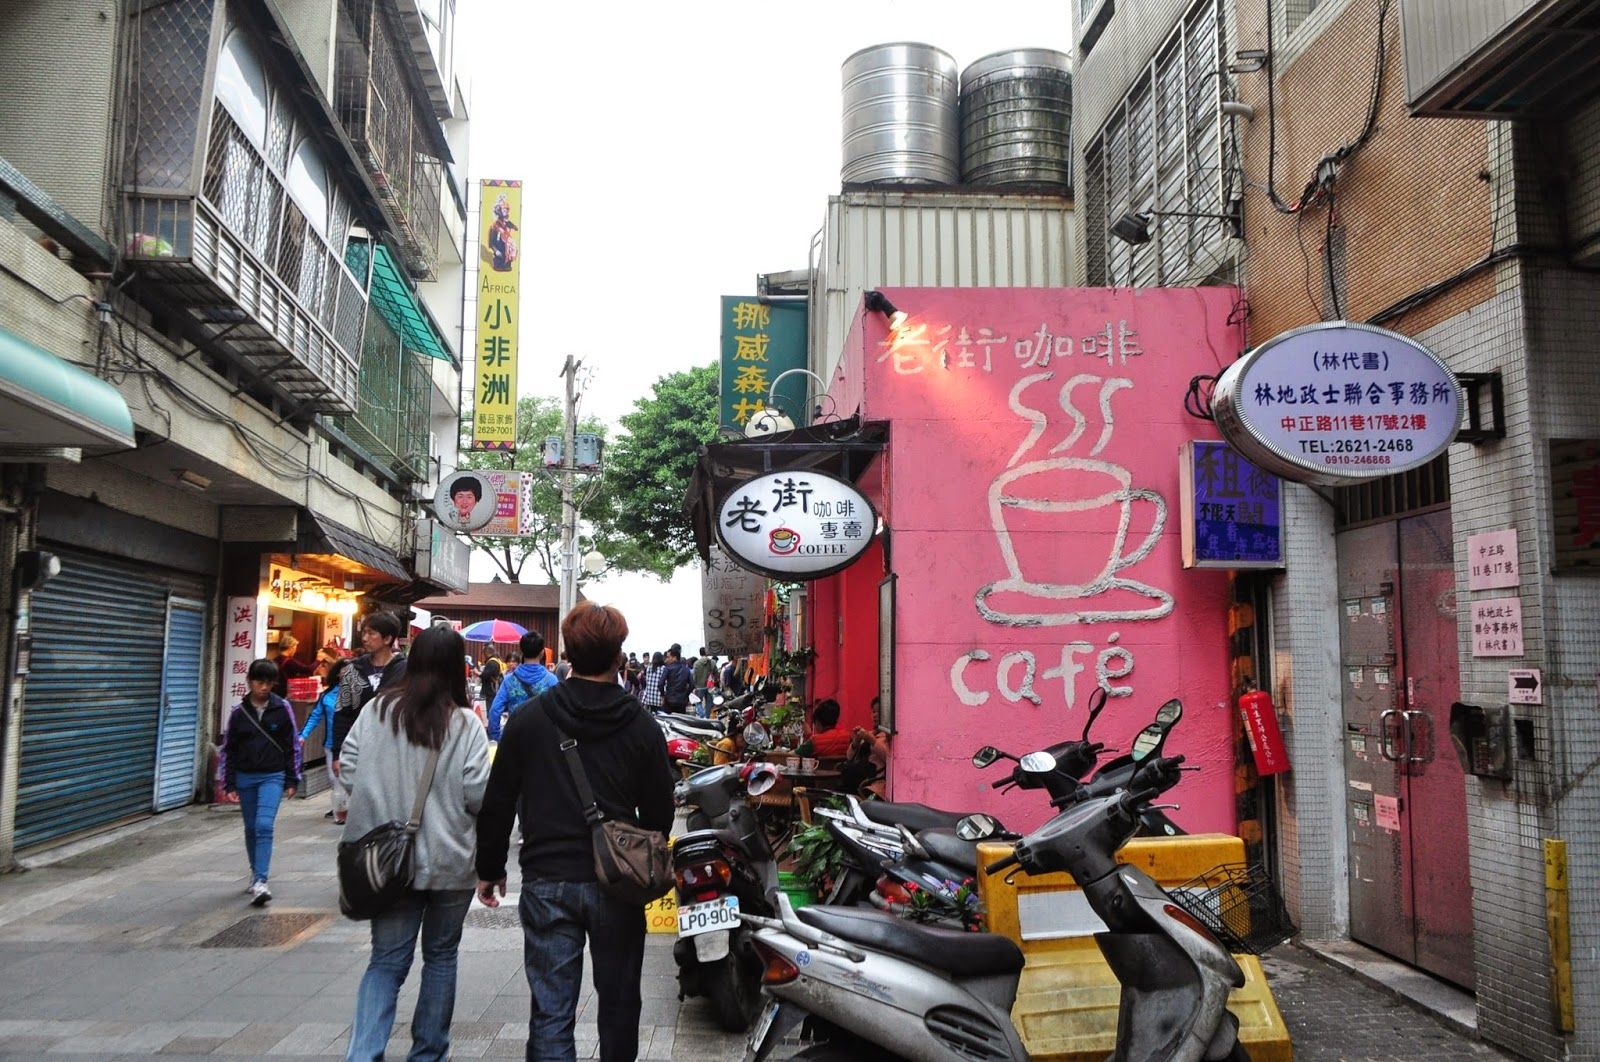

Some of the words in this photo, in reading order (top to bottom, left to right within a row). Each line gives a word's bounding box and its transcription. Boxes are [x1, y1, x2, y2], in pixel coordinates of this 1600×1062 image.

[480, 299, 512, 405] 小非洲
[877, 319, 1143, 374] 老街咖啡
[1313, 351, 1389, 372] (林代書)
[1254, 381, 1451, 407] 林地政士聯合事務所
[1281, 414, 1427, 432] 中正路11巷17號2樓
[1299, 439, 1413, 454] TEL:2621-2468
[726, 478, 813, 534] 老街
[813, 500, 856, 518] 咖啡
[820, 521, 863, 540] 專賣
[797, 544, 848, 556] COFFEE
[1479, 544, 1505, 559] 中正路
[950, 632, 1134, 710] café
